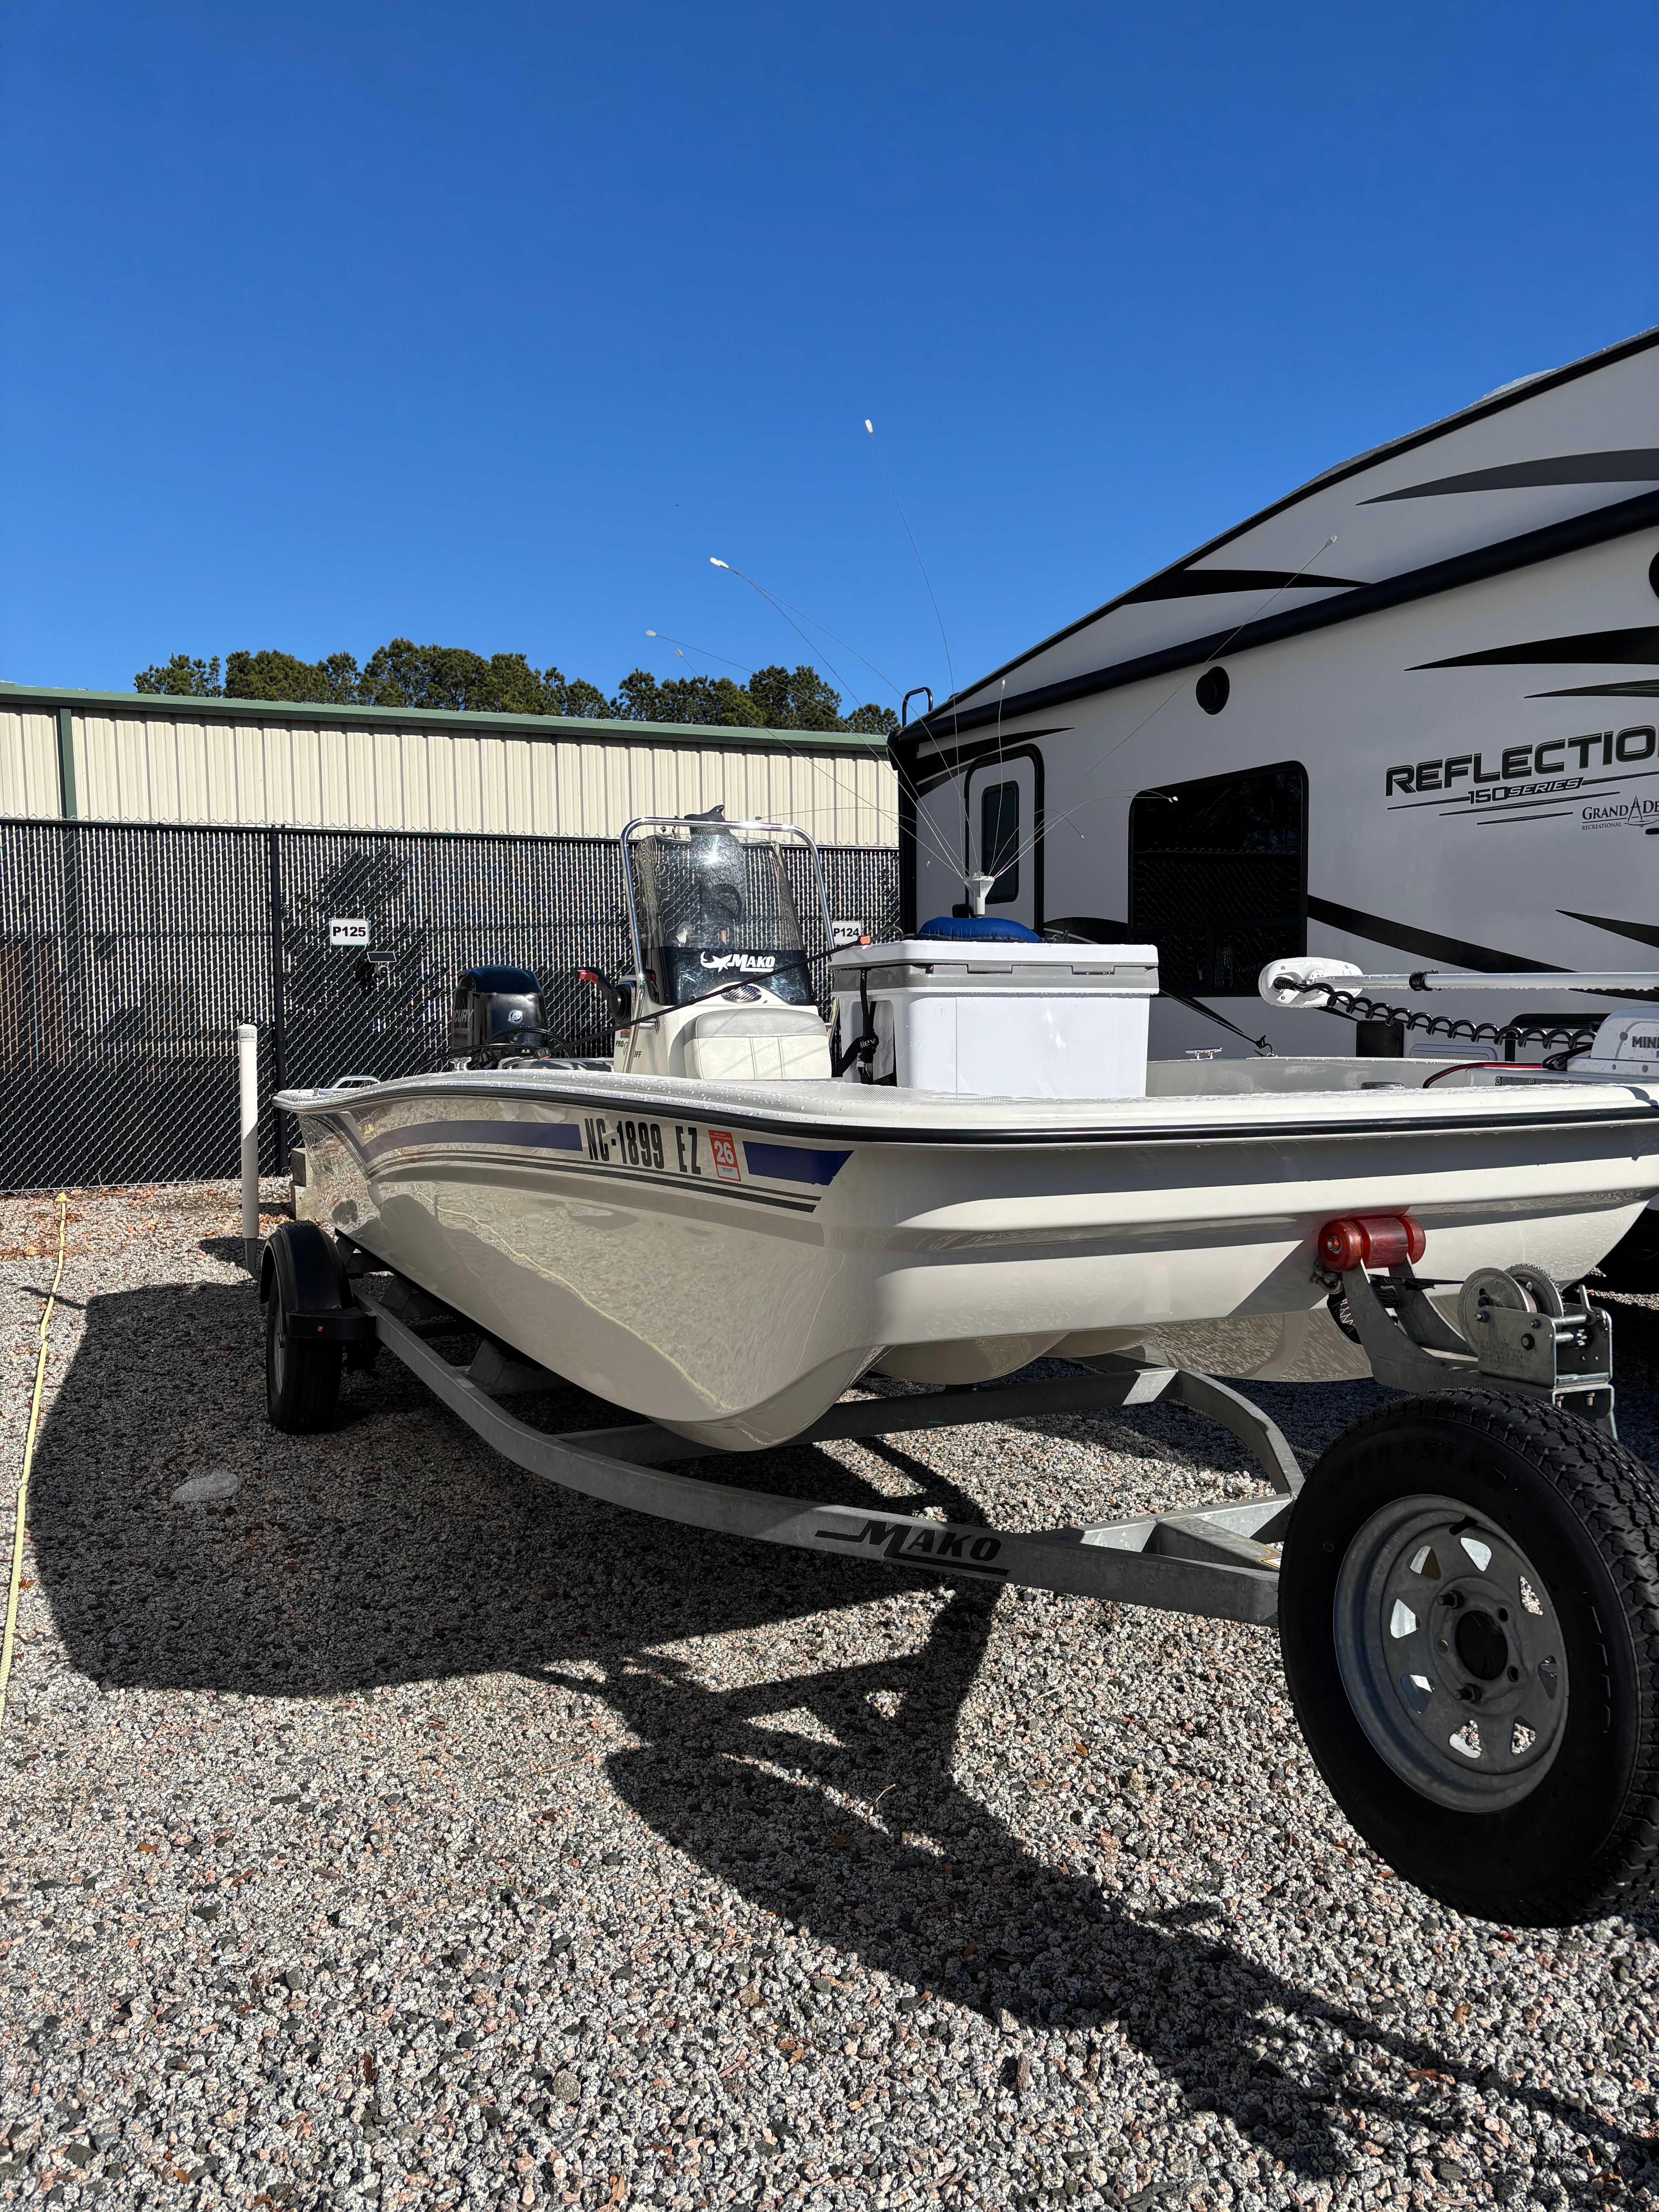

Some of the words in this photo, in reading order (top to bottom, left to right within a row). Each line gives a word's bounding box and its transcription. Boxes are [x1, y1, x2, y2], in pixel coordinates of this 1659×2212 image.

[1386, 725, 1659, 796] REFLECTIO
[1468, 787, 1508, 804] 150
[1508, 778, 1580, 797] SERIES
[1582, 805, 1629, 820] GRAND
[1582, 821, 1622, 830] RECREATIONAL
[333, 926, 366, 937] P125
[833, 927, 859, 937] P124
[726, 954, 775, 972] MAKO
[454, 1009, 474, 1023] CURY
[1632, 1036, 1659, 1049] MIN
[584, 1118, 665, 1169] NC-1899
[675, 1125, 702, 1175] EZ
[714, 1140, 734, 1164] 26
[815, 1519, 1010, 1577] MAKO
